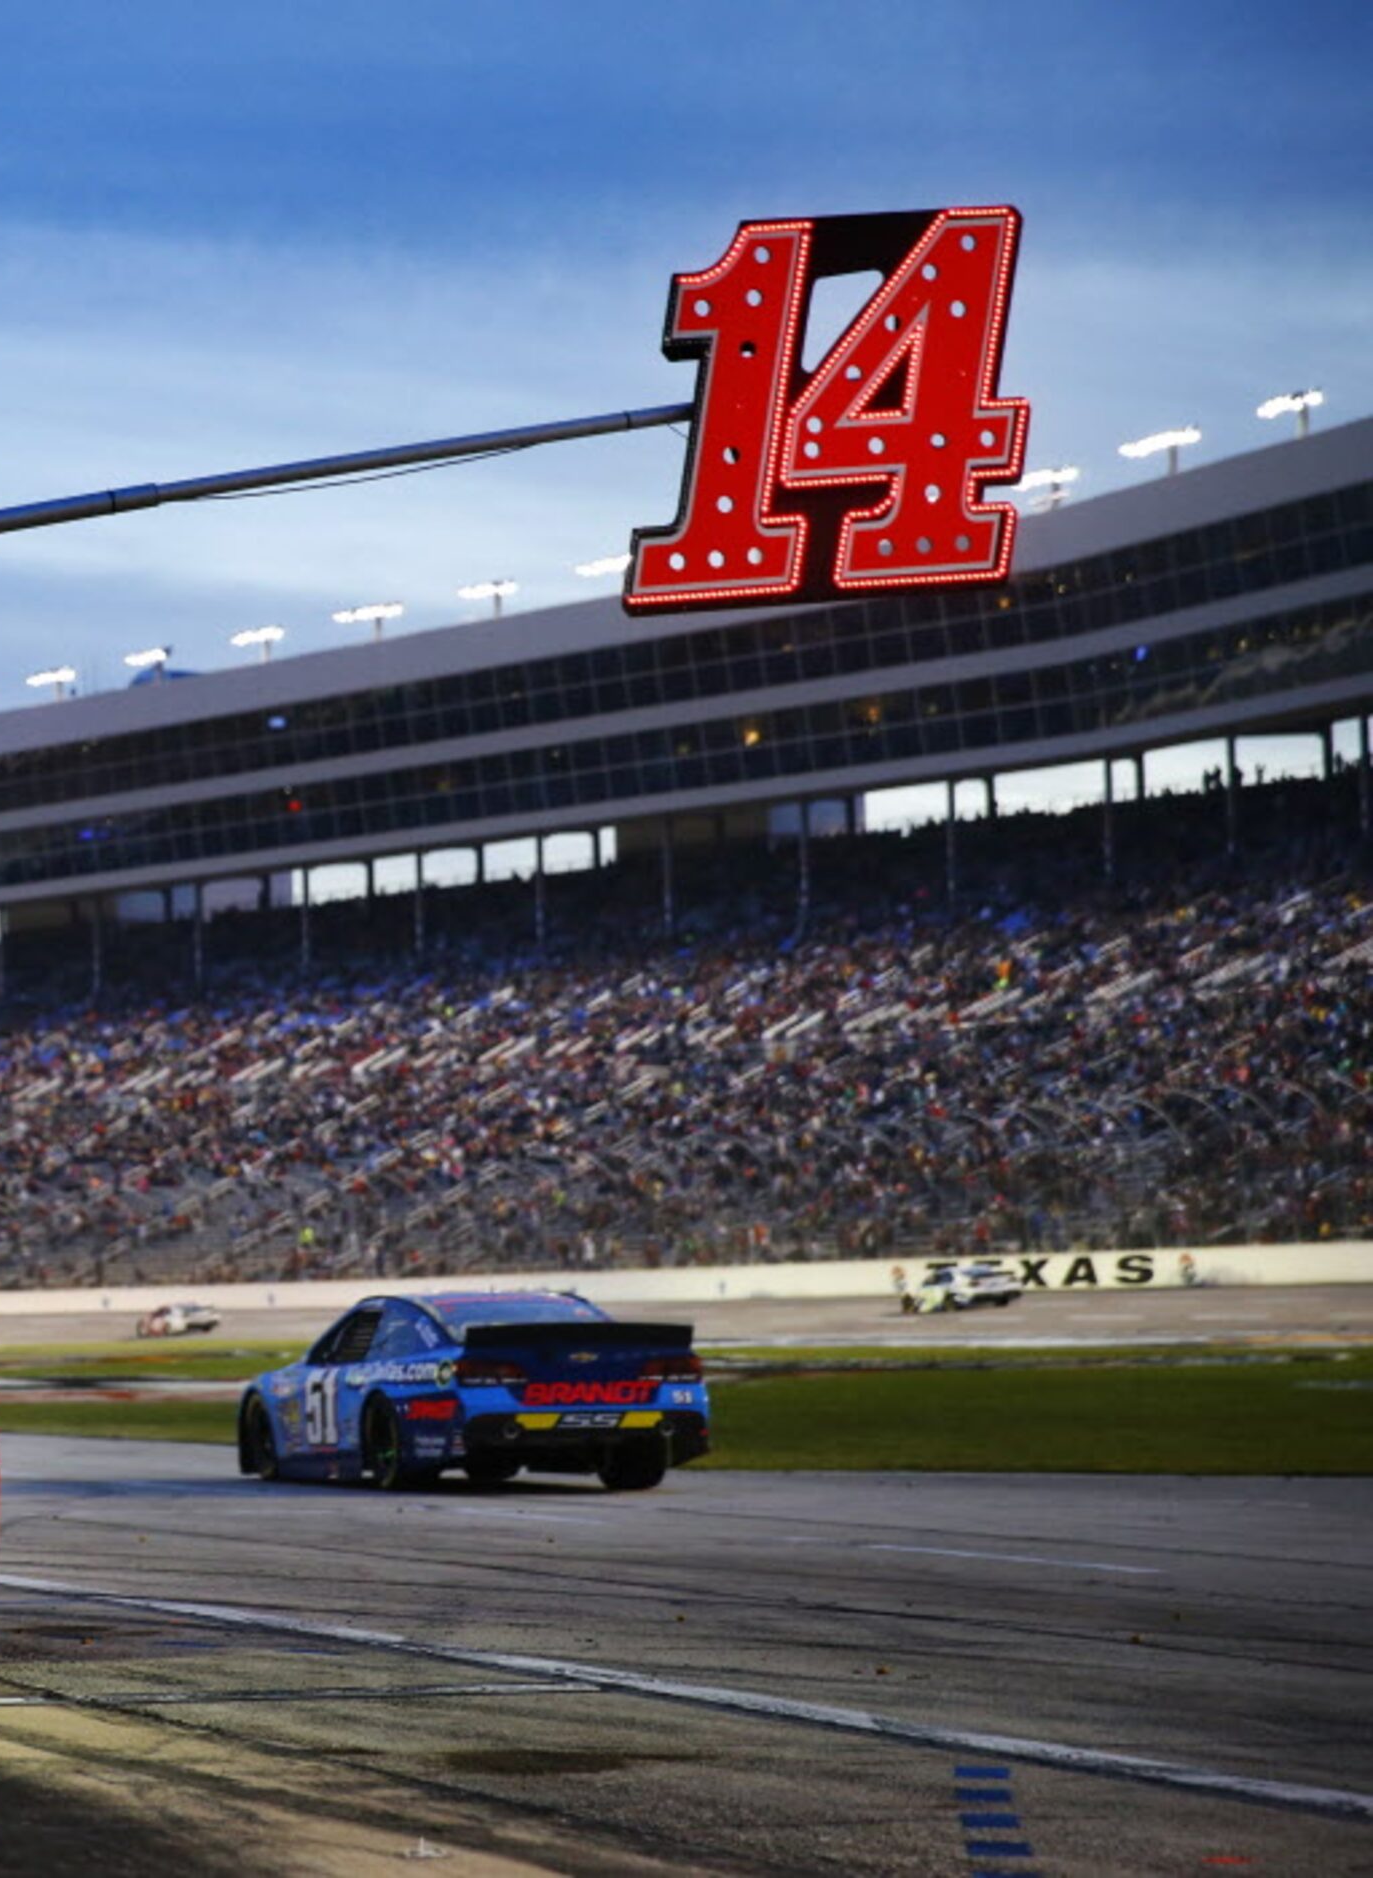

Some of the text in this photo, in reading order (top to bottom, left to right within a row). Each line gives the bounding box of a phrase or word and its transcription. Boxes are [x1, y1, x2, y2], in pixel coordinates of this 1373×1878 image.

[624, 206, 1029, 615] 14
[926, 1254, 1154, 1287] XAS
[304, 1366, 339, 1445] 51
[521, 1379, 660, 1406] BRANDT
[672, 1390, 693, 1404] 51
[557, 1413, 622, 1428] SS
